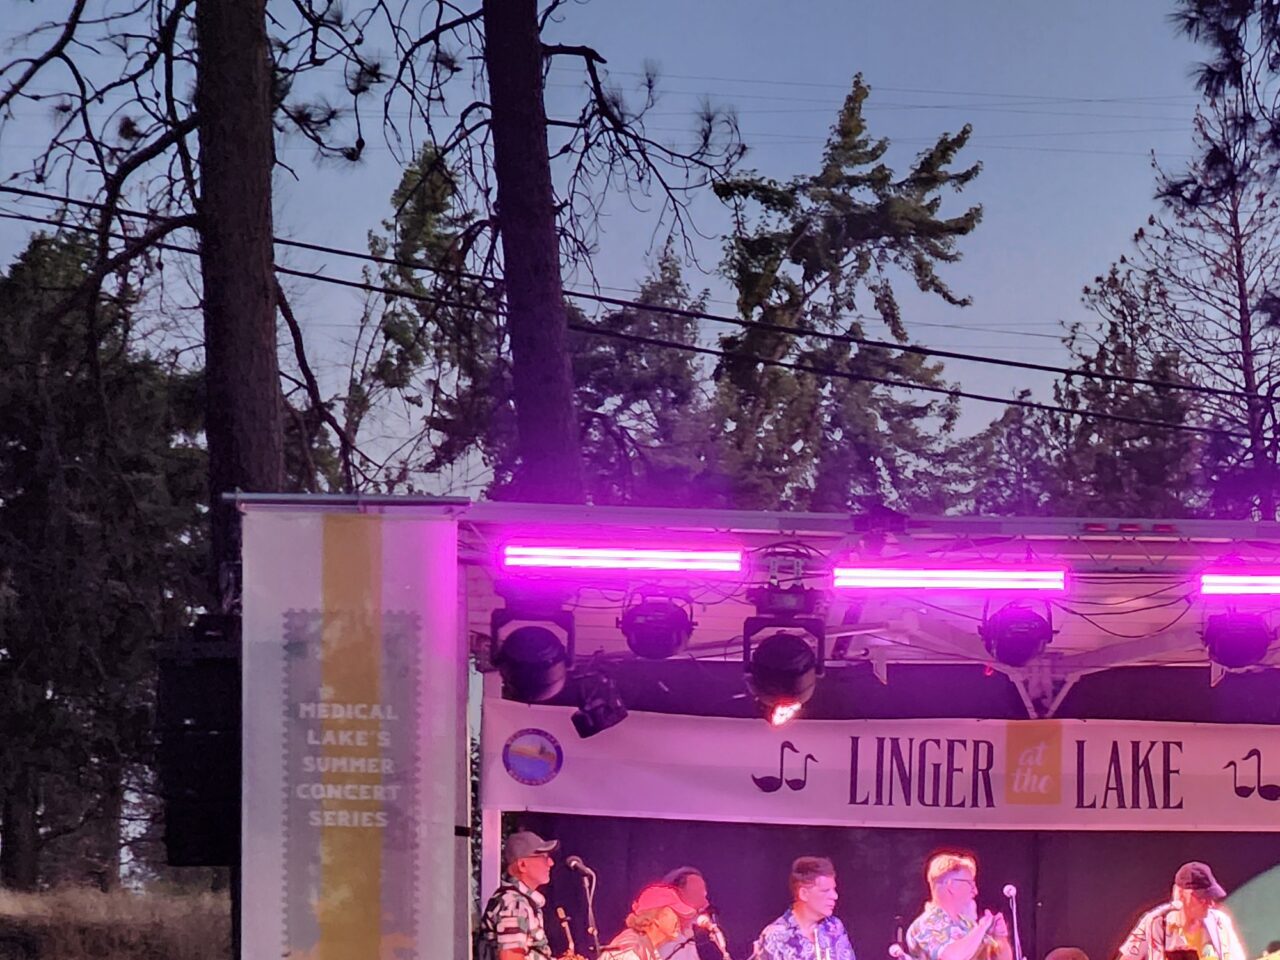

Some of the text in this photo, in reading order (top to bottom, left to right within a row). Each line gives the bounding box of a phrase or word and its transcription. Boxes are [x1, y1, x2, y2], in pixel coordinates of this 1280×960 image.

[298, 702, 399, 720] MEDICAL
[306, 730, 392, 747] LAKE'S
[302, 755, 395, 774] SUMMER
[847, 735, 1184, 810] LINGER at the LAKE
[296, 782, 401, 801] CONCERT
[308, 810, 389, 827] SERIES
